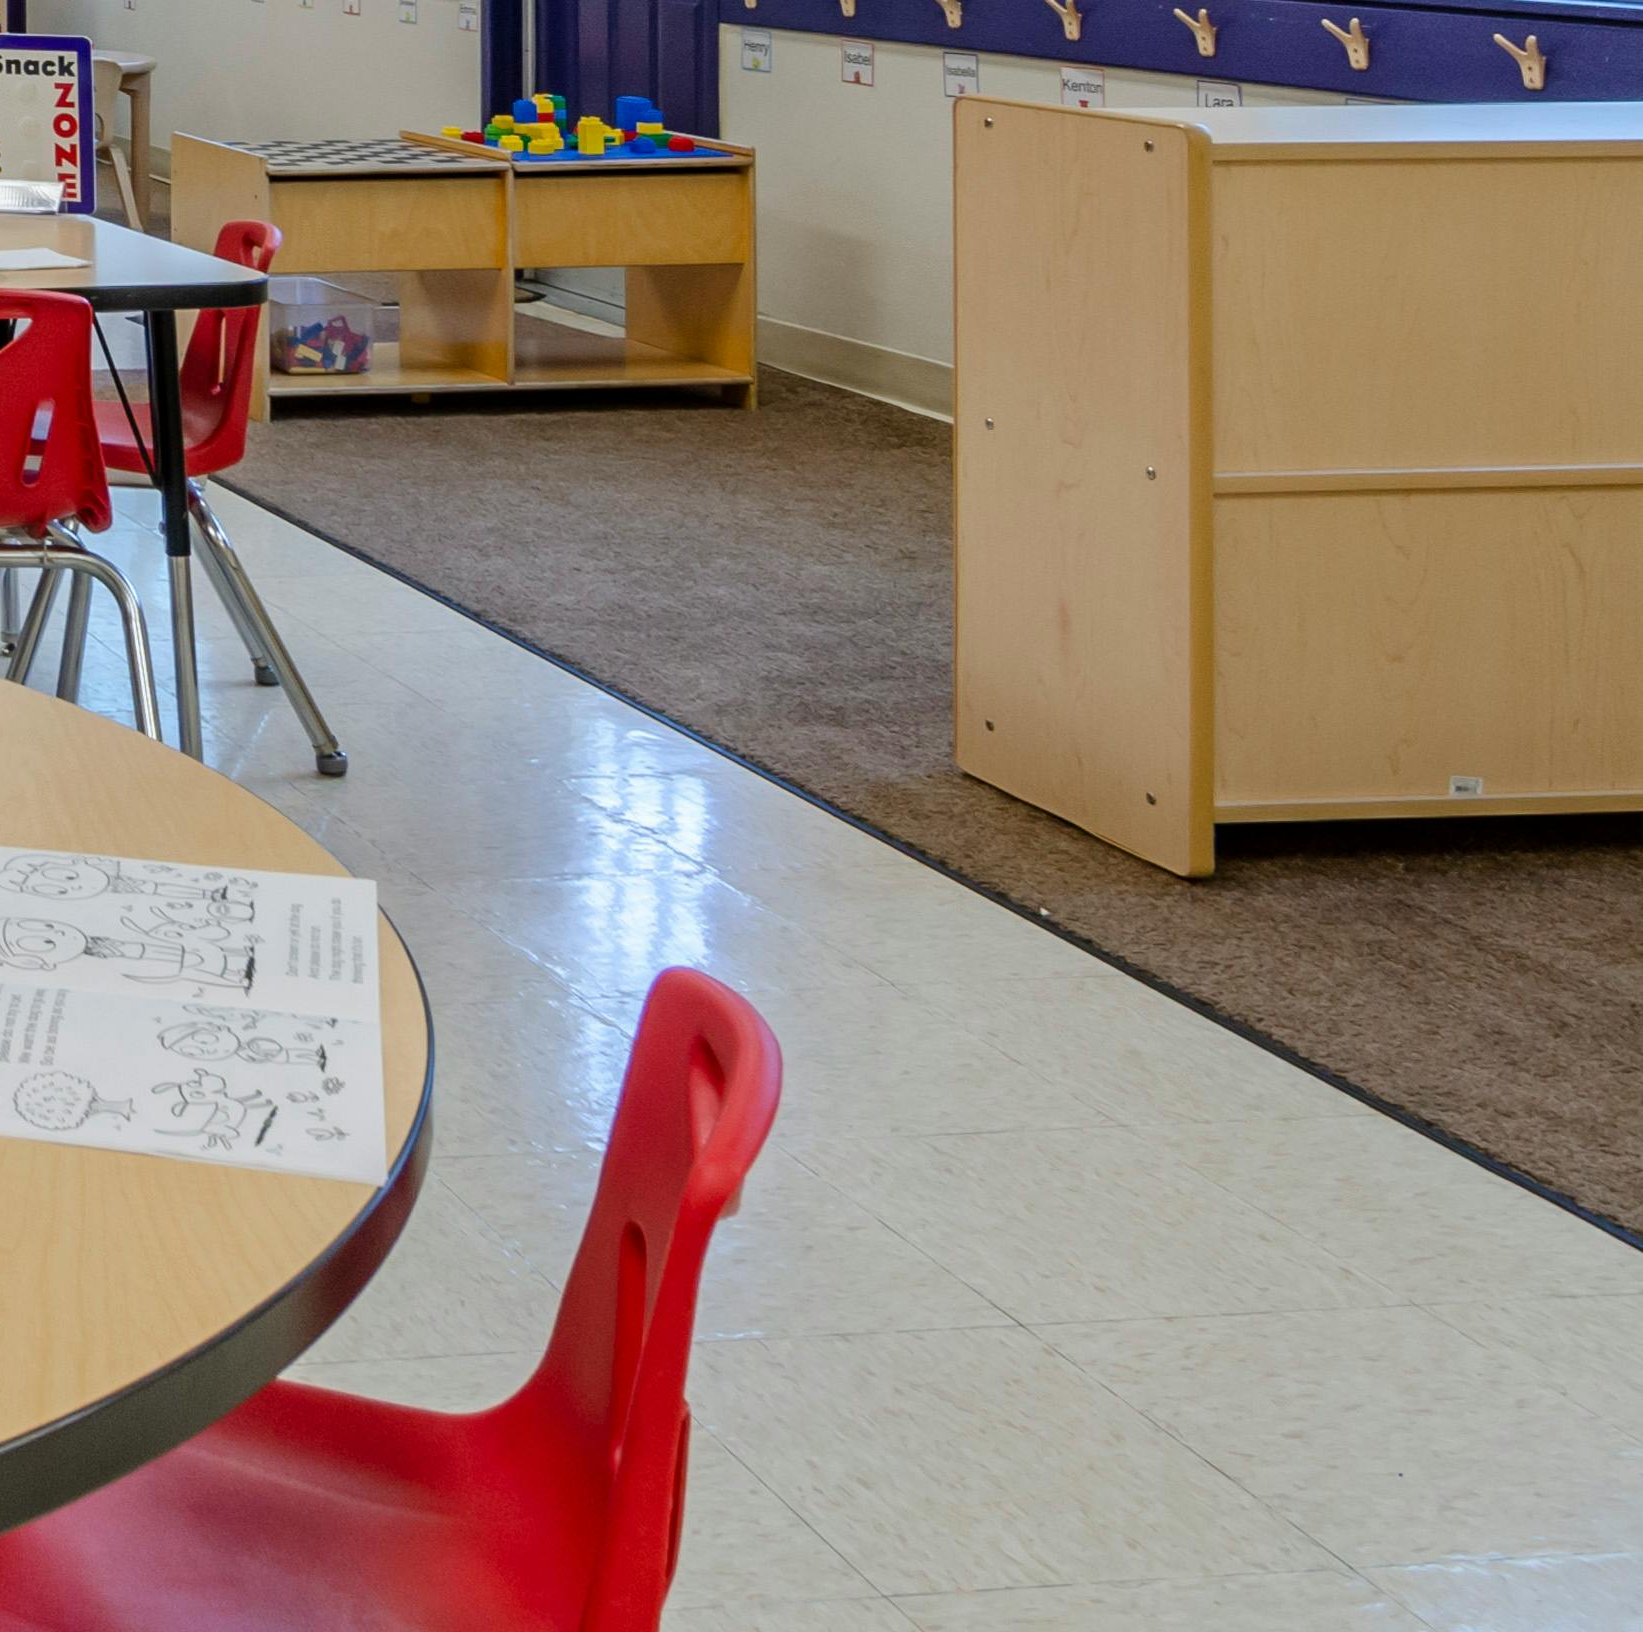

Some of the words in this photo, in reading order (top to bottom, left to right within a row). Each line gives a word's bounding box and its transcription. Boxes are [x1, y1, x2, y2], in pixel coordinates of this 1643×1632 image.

[744, 40, 769, 57] Henry
[843, 50, 872, 66] Isabel
[1062, 78, 1103, 95] Kenton
[54, 82, 78, 200] ZONE
